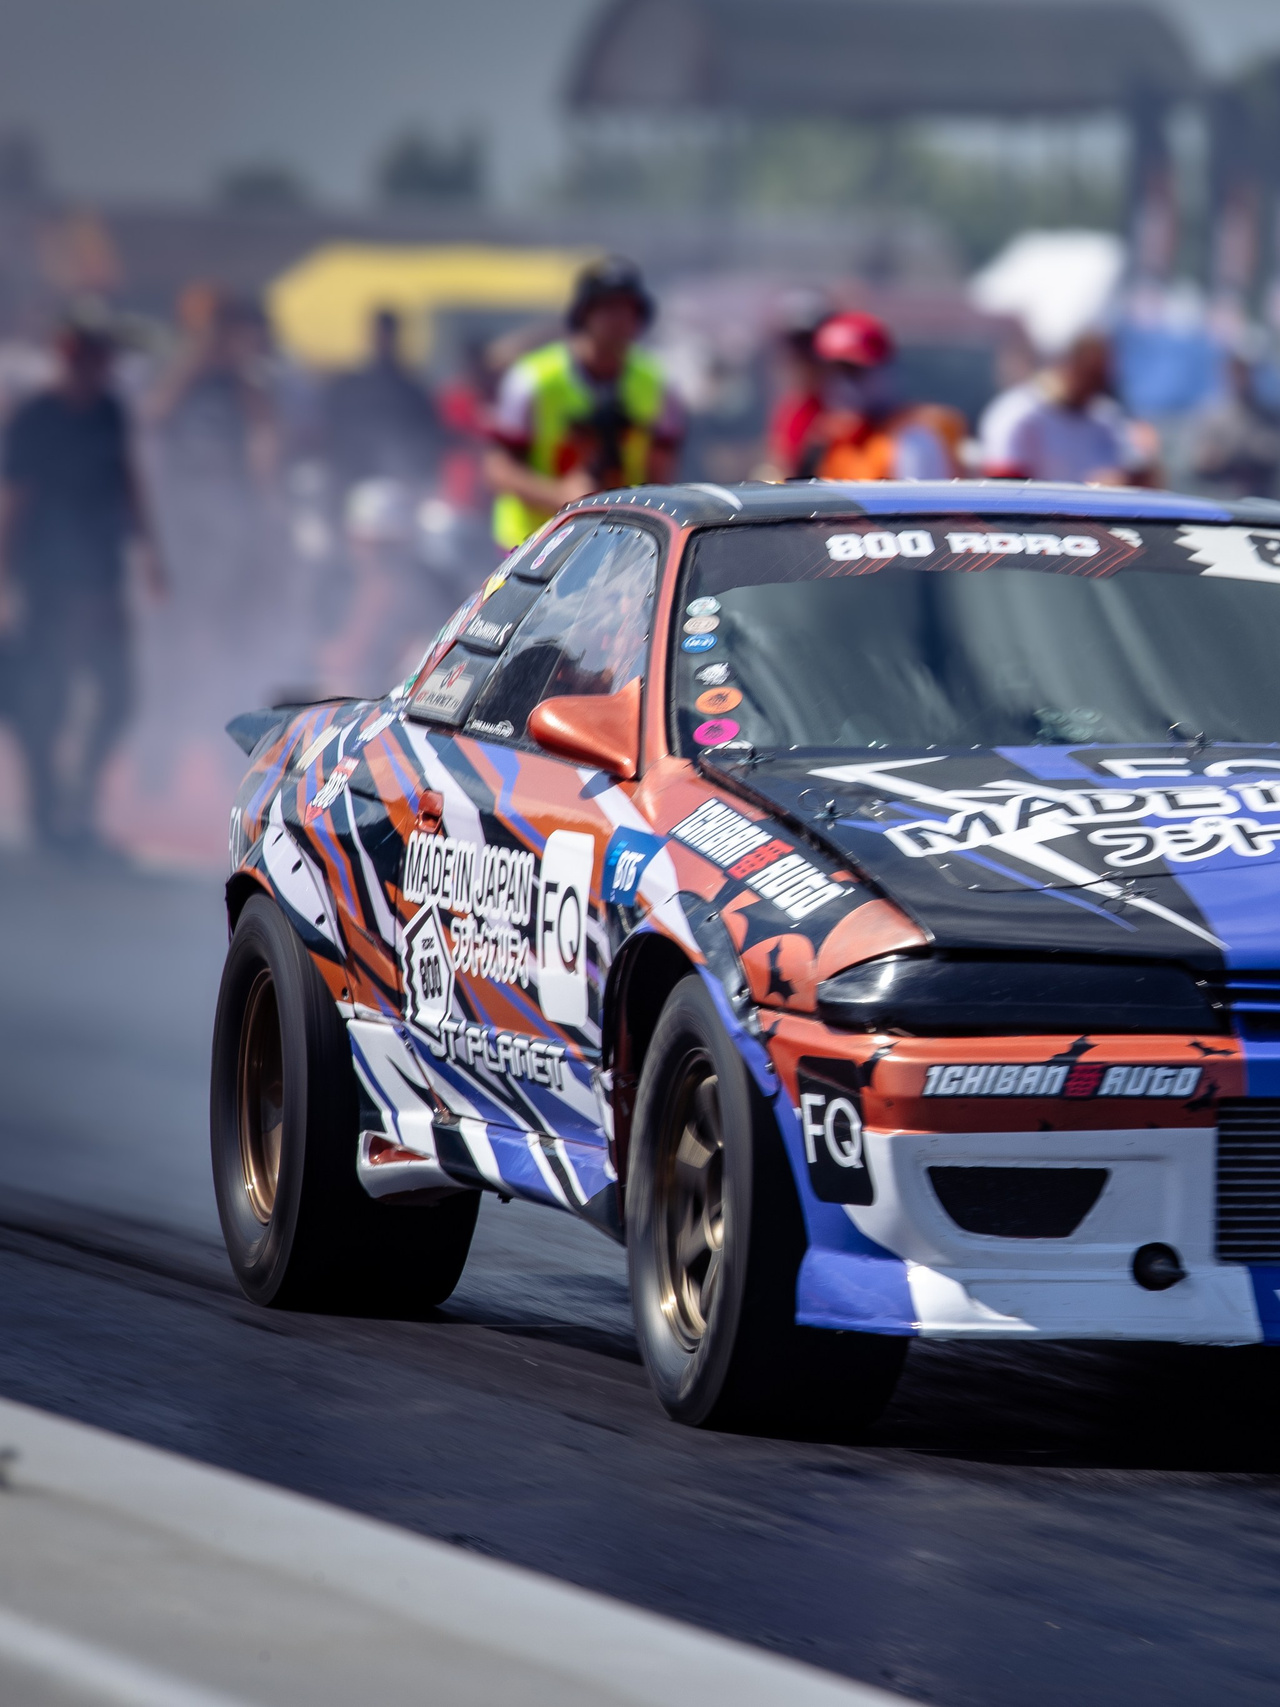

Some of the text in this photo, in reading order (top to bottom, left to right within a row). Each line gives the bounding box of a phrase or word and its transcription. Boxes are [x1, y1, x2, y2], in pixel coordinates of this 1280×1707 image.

[826, 529, 1100, 562] 800 RDRC
[403, 830, 535, 926] MADE IN JAPAN
[744, 853, 847, 921] AUTO
[542, 880, 582, 977] FQ
[420, 953, 443, 1000] 800
[1097, 1066, 1203, 1097] AUTO
[800, 1092, 864, 1170] FQ
